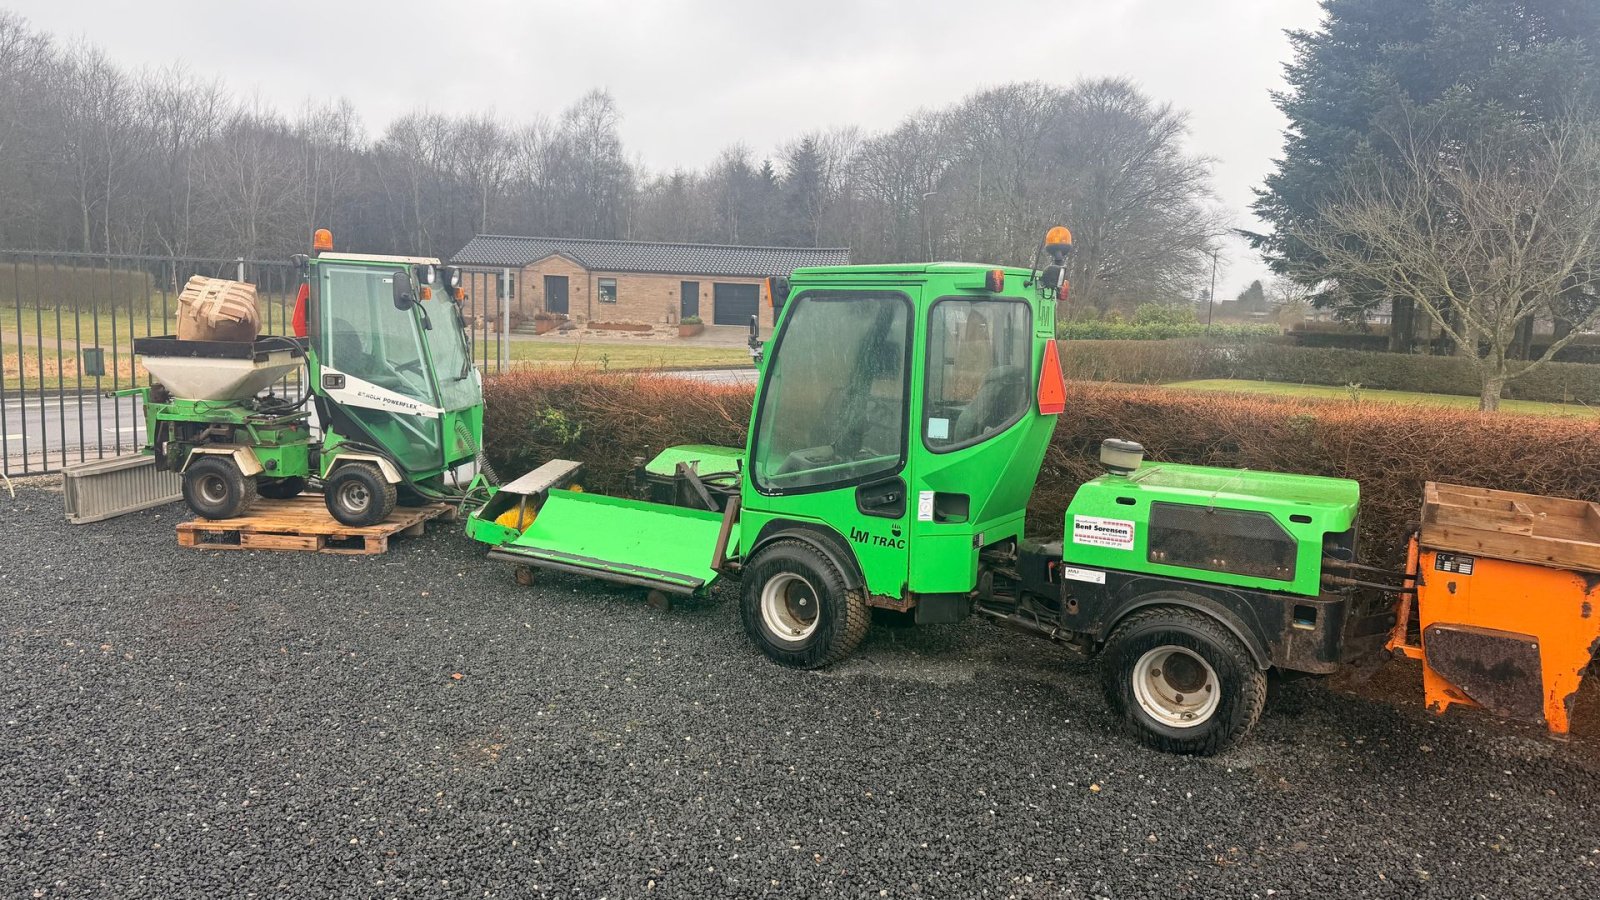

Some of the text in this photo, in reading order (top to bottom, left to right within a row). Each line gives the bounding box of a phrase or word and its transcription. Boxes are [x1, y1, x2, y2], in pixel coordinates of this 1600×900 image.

[383, 397, 417, 409] POWERFLEX
[1075, 522, 1092, 530] Bent
[850, 526, 906, 550] LM TRAC
